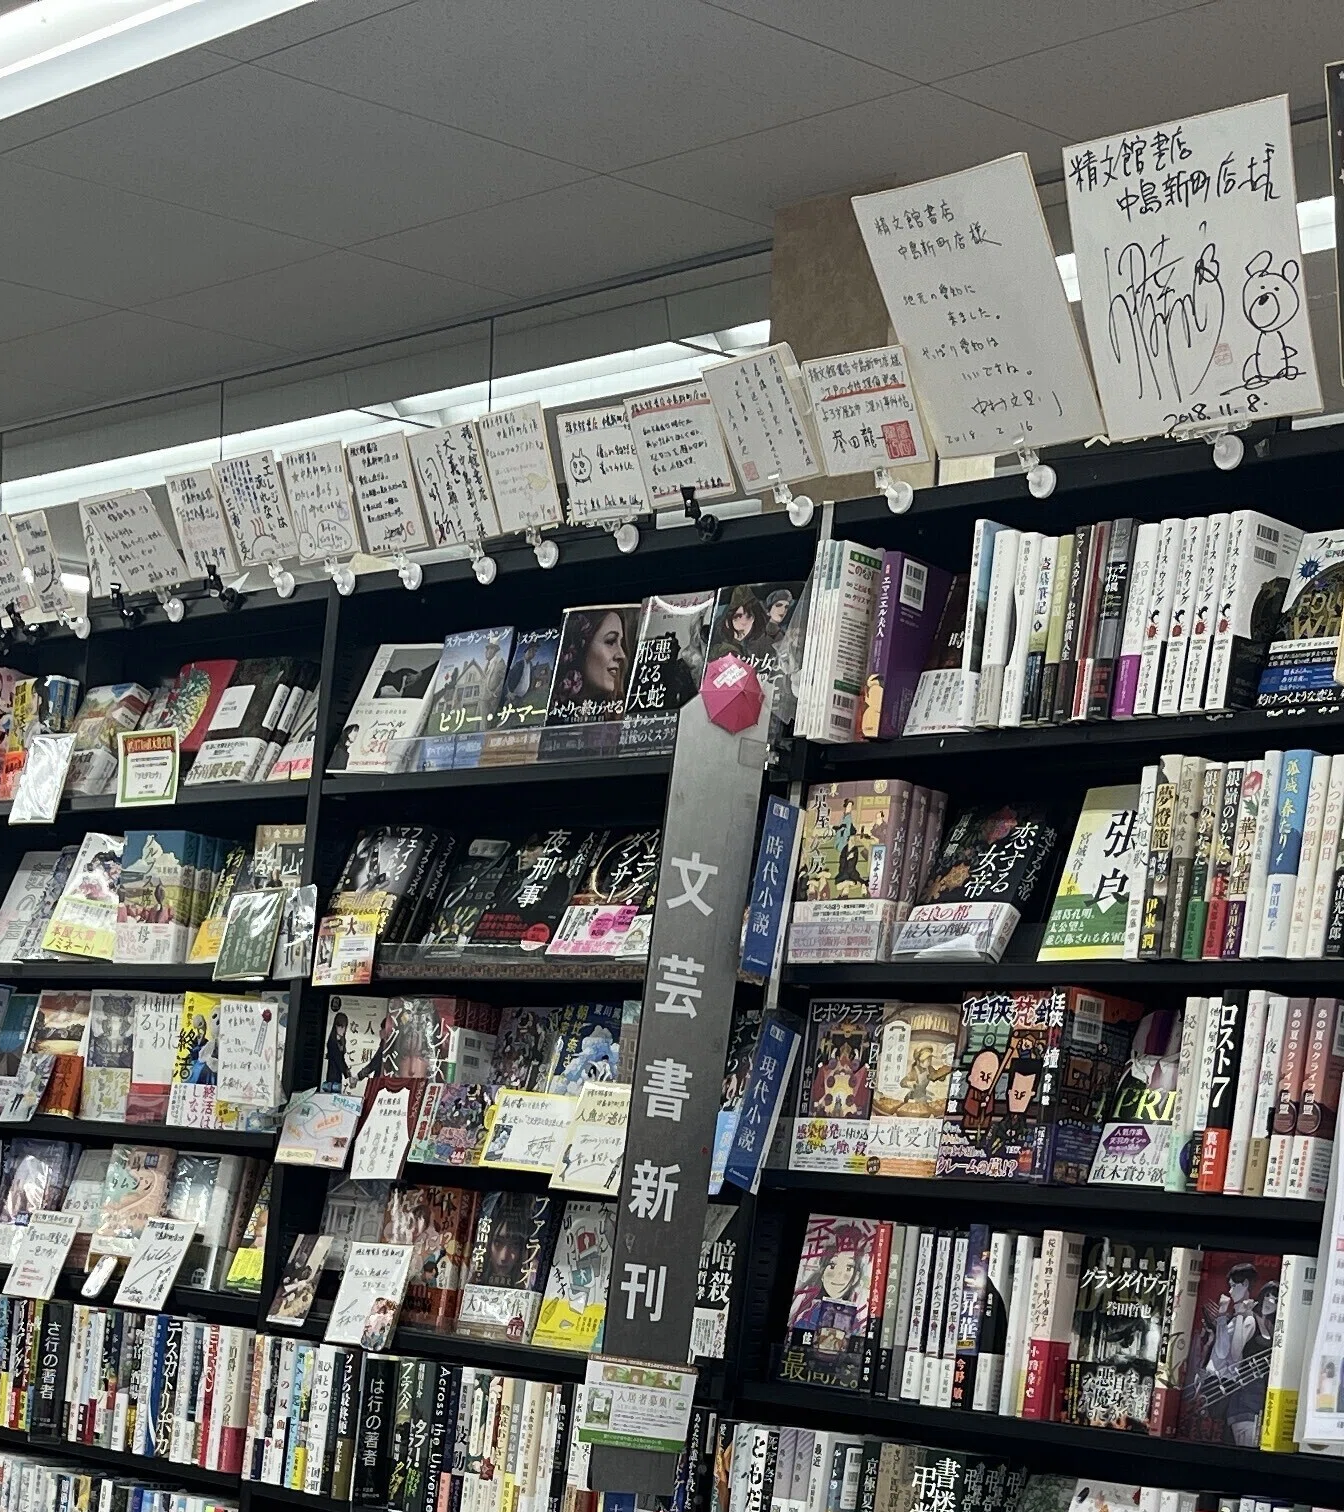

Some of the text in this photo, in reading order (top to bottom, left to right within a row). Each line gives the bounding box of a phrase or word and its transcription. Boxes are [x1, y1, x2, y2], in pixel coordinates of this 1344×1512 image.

[1069, 126, 1192, 192] 精文館書店
[875, 199, 955, 236] 精文館書店
[898, 222, 1002, 260] 中島新町店様
[903, 284, 976, 307] 地元の愛知に
[947, 306, 1002, 327] 来ました。
[922, 337, 999, 360] やっぱり愛知は
[1155, 527, 1174, 605] フォース・ウィング
[872, 574, 892, 640] エマニエル夫人
[635, 640, 672, 663] 邪悪
[638, 663, 661, 683] なる
[369, 717, 406, 730] ノーベル
[628, 685, 665, 710] 大蛇
[1216, 768, 1241, 866] 銀嶺のかなた
[1300, 780, 1323, 862] いつかの朔日
[515, 829, 570, 910] 夜刑事
[751, 835, 787, 938] 時代小説
[621, 850, 719, 1322] 文芸書新刊
[1211, 1005, 1239, 1107] ロスト7
[737, 1053, 779, 1156] 現代小説
[869, 1125, 938, 1148] 大賞受賞
[1201, 1131, 1220, 1175] 真山仁
[708, 1240, 735, 1304] 暗殺
[1102, 1301, 1161, 1318] 誉田哲也
[38, 1320, 62, 1401] さ行の著者
[153, 1320, 181, 1456] テスカトリポカ
[362, 1376, 385, 1468] は行の著者
